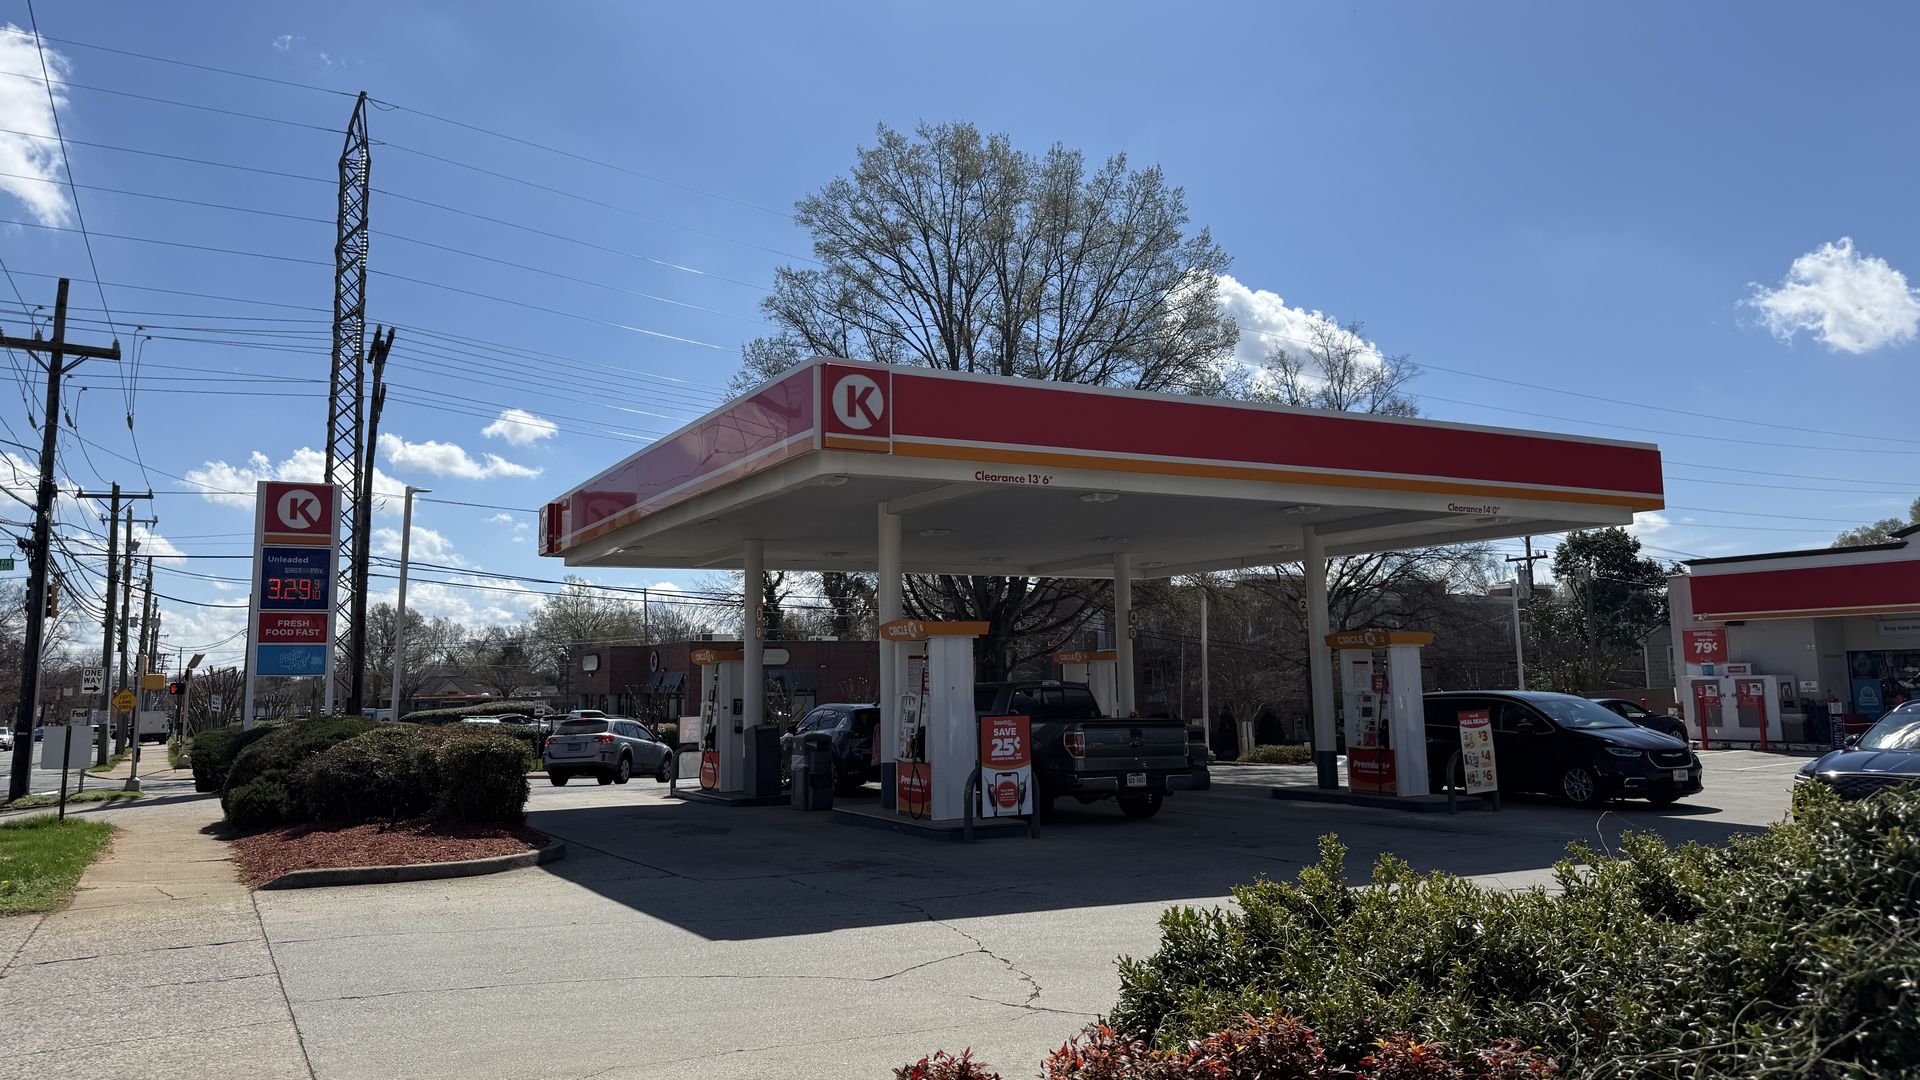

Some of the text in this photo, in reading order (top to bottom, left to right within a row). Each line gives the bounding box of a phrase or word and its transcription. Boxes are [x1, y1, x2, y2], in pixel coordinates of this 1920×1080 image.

[975, 470, 1025, 483] Clearance
[1448, 503, 1482, 513] Clearance
[268, 556, 309, 564] Unleaded
[268, 578, 311, 599] 3.29
[277, 619, 310, 627] FRESH
[265, 628, 321, 636] FOOD FAST
[888, 625, 908, 636] CIRCLE
[908, 621, 917, 638] K
[1337, 635, 1364, 644] CIRCLE
[1364, 632, 1377, 646] K
[1694, 641, 1718, 653] 79¢
[993, 727, 1017, 736] SAVE
[1478, 730, 1488, 741] $3
[991, 736, 1021, 757] 25¢
[1481, 750, 1491, 761] $4
[1483, 770, 1493, 781] $6
